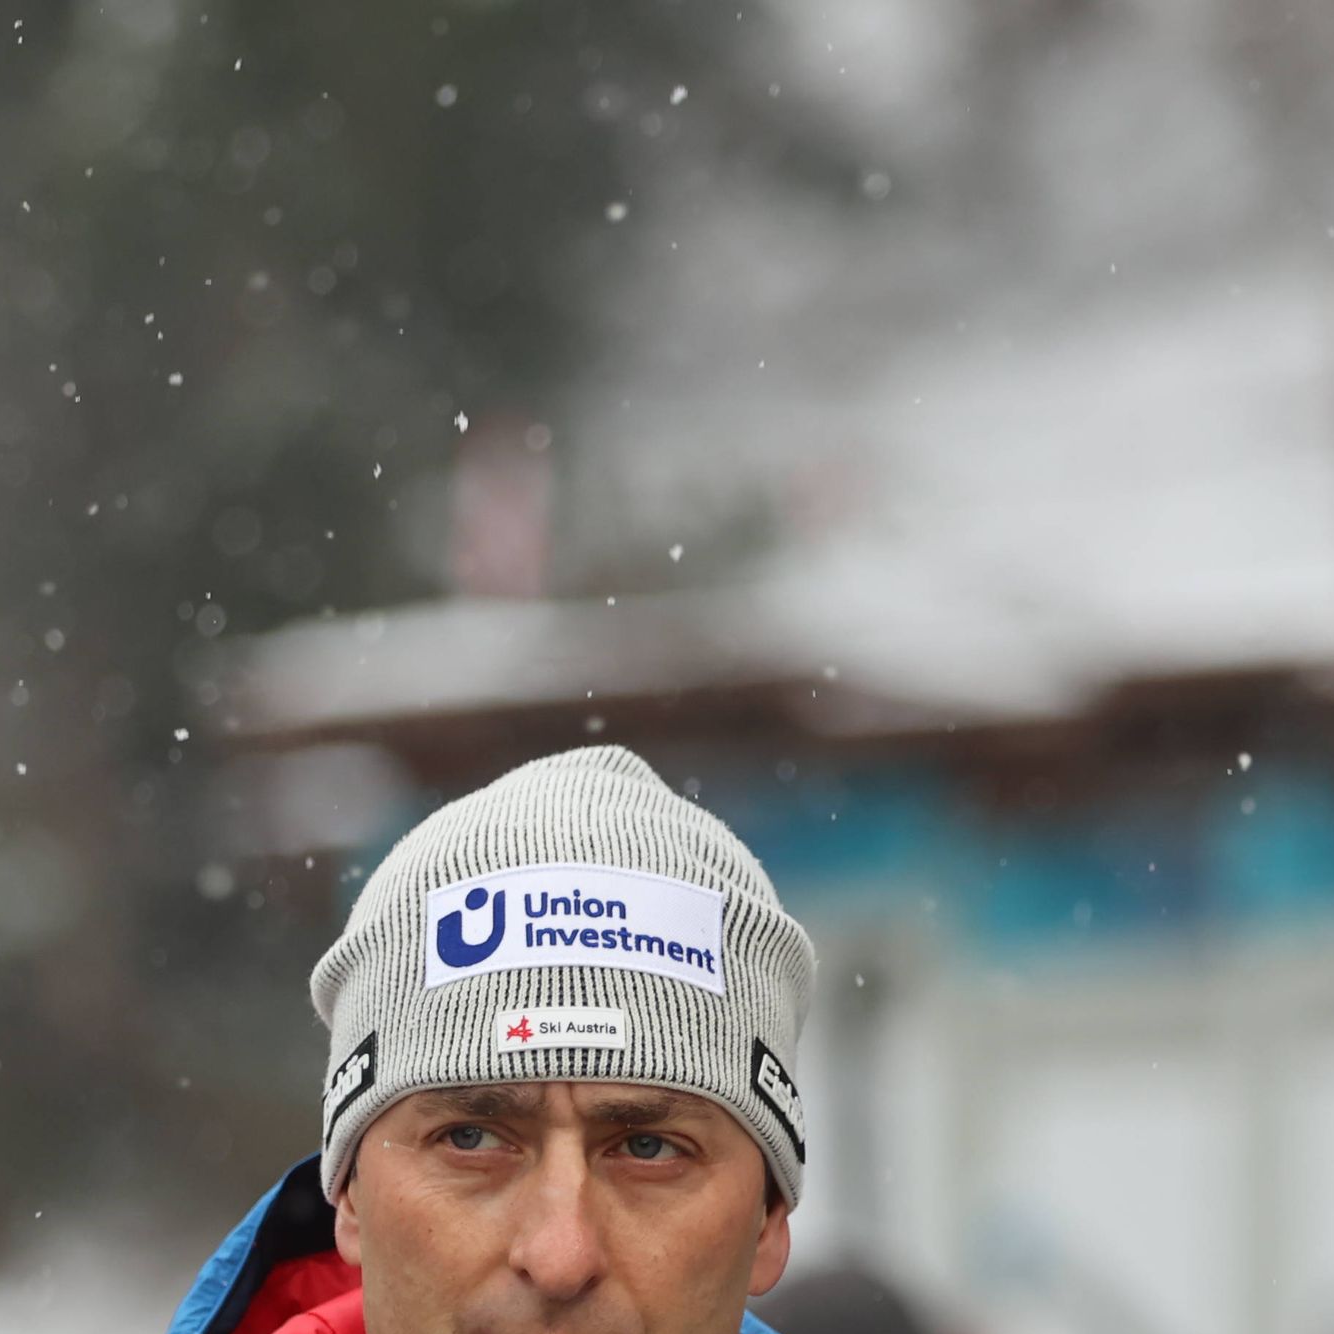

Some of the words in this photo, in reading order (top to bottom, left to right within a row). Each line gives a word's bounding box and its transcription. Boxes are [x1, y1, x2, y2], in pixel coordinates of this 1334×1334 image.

[524, 889, 626, 919] Union
[525, 922, 715, 974] Investment
[539, 1021, 561, 1034] Ski
[566, 1021, 617, 1035] Austria
